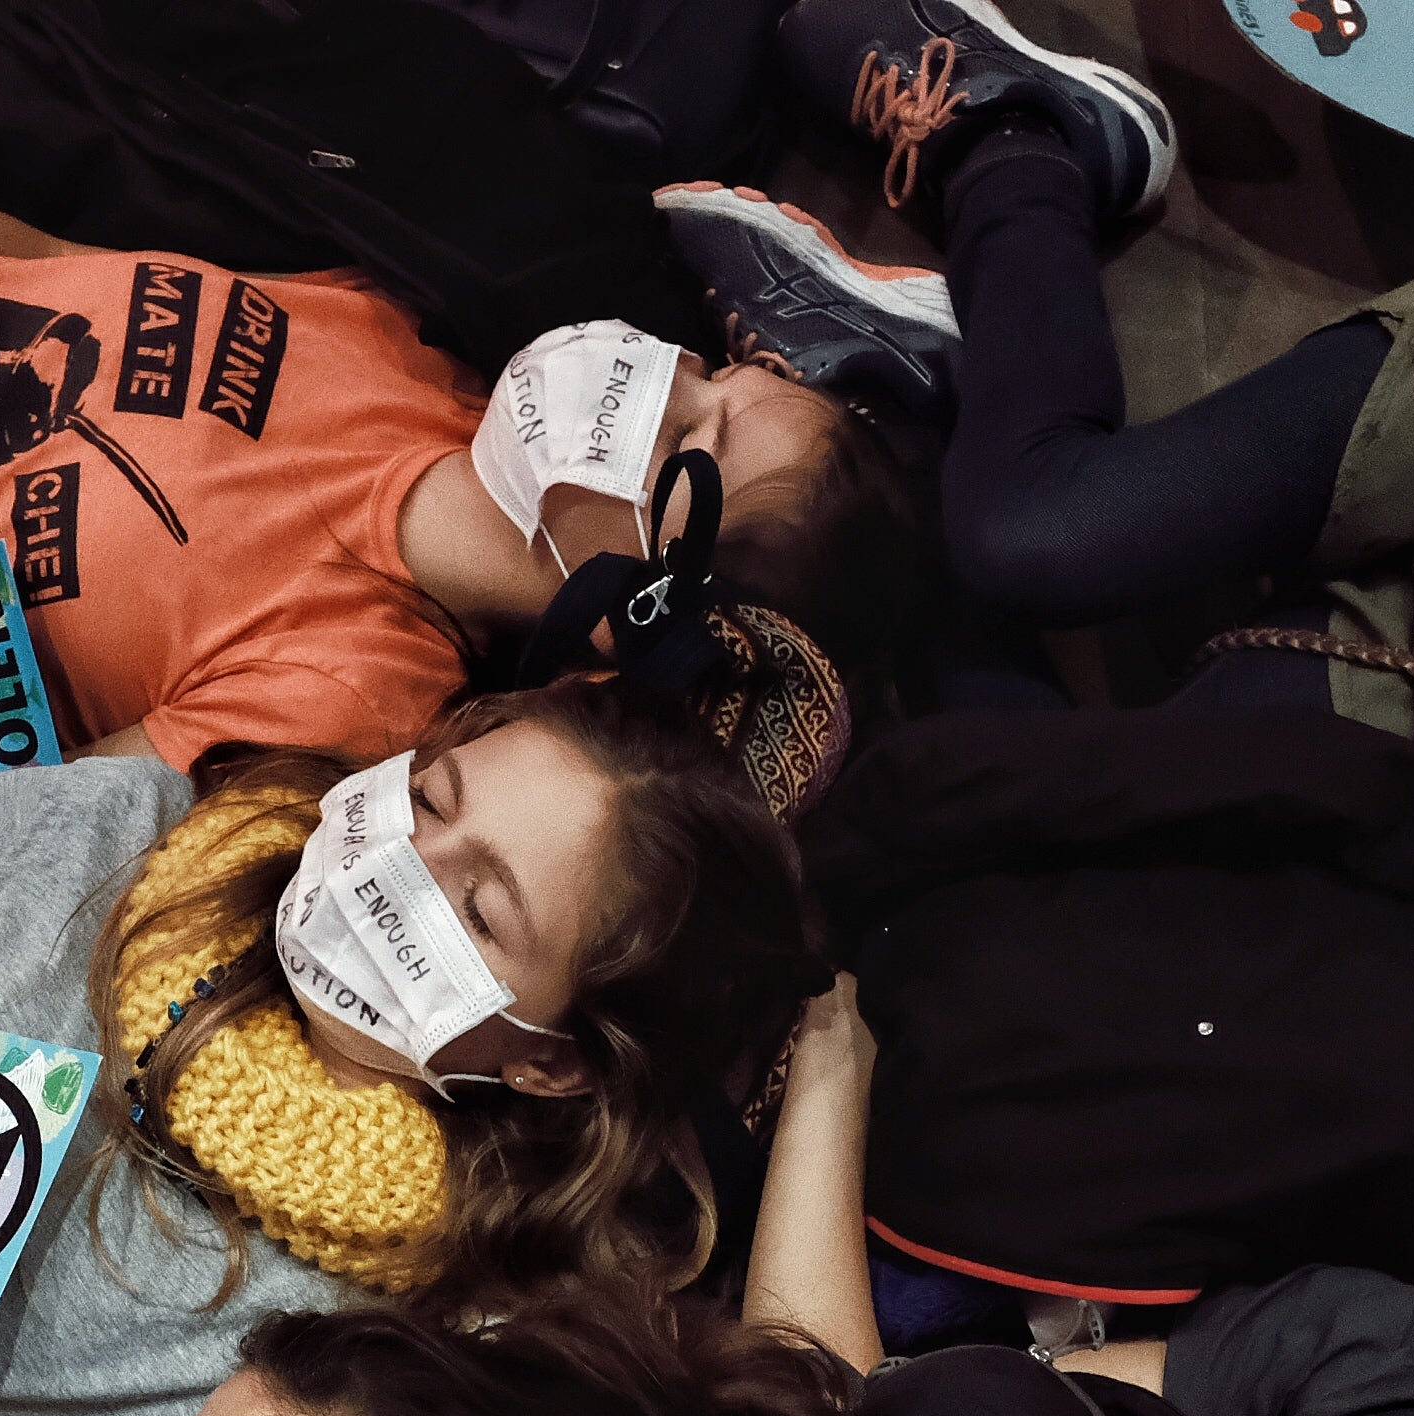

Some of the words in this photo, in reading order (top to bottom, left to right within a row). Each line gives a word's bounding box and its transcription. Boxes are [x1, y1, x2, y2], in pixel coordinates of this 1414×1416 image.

[129, 263, 187, 400] MATE
[211, 284, 276, 428] DRINK
[587, 357, 634, 463] ENOUGH
[354, 877, 431, 983] ENOUGH
